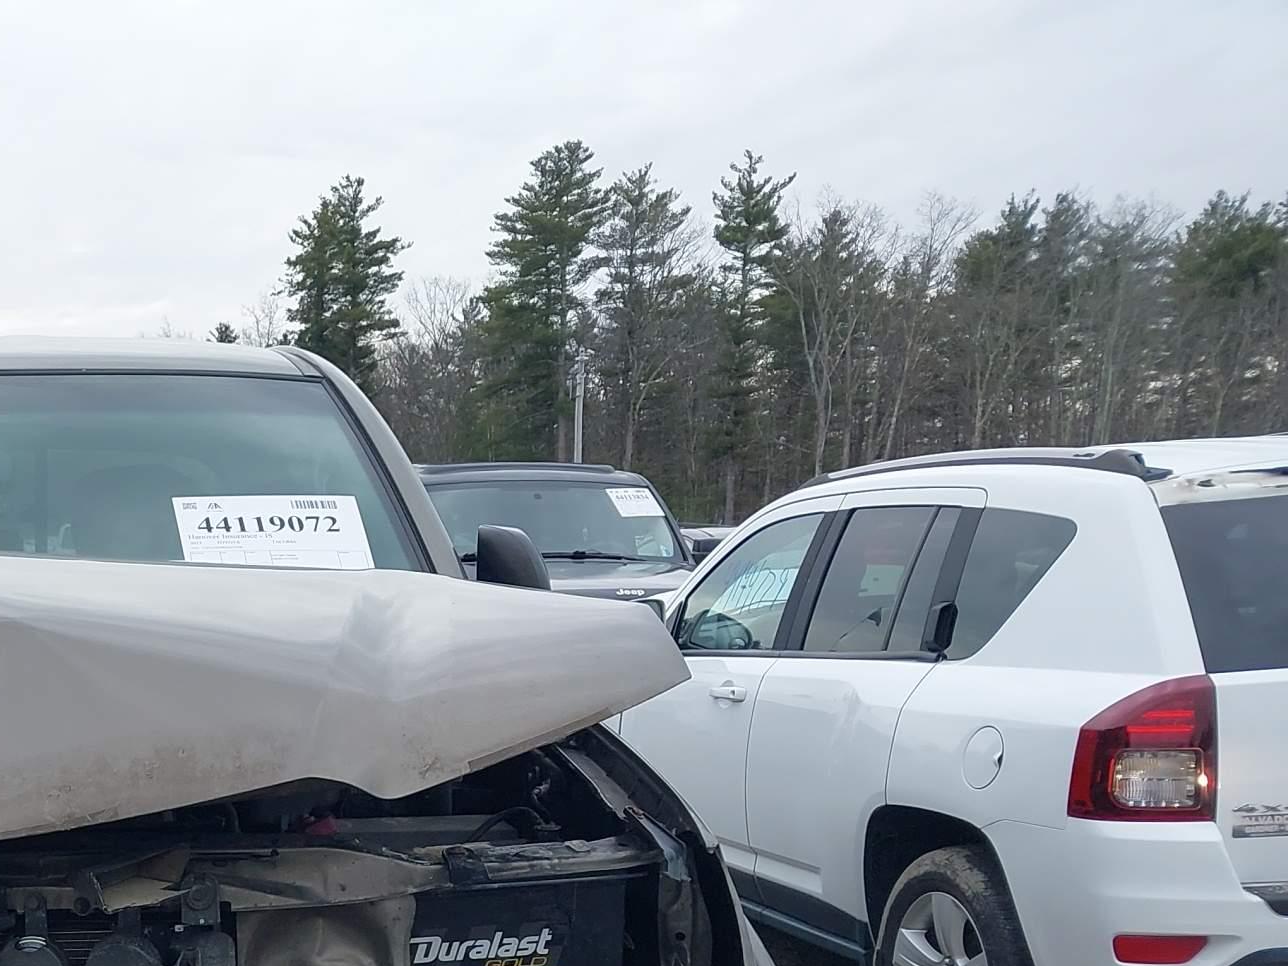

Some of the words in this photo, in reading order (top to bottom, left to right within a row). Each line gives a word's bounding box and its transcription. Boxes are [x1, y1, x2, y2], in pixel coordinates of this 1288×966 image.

[197, 516, 340, 533] 44119072
[616, 588, 645, 596] Jeep
[409, 928, 553, 964] Duralast
